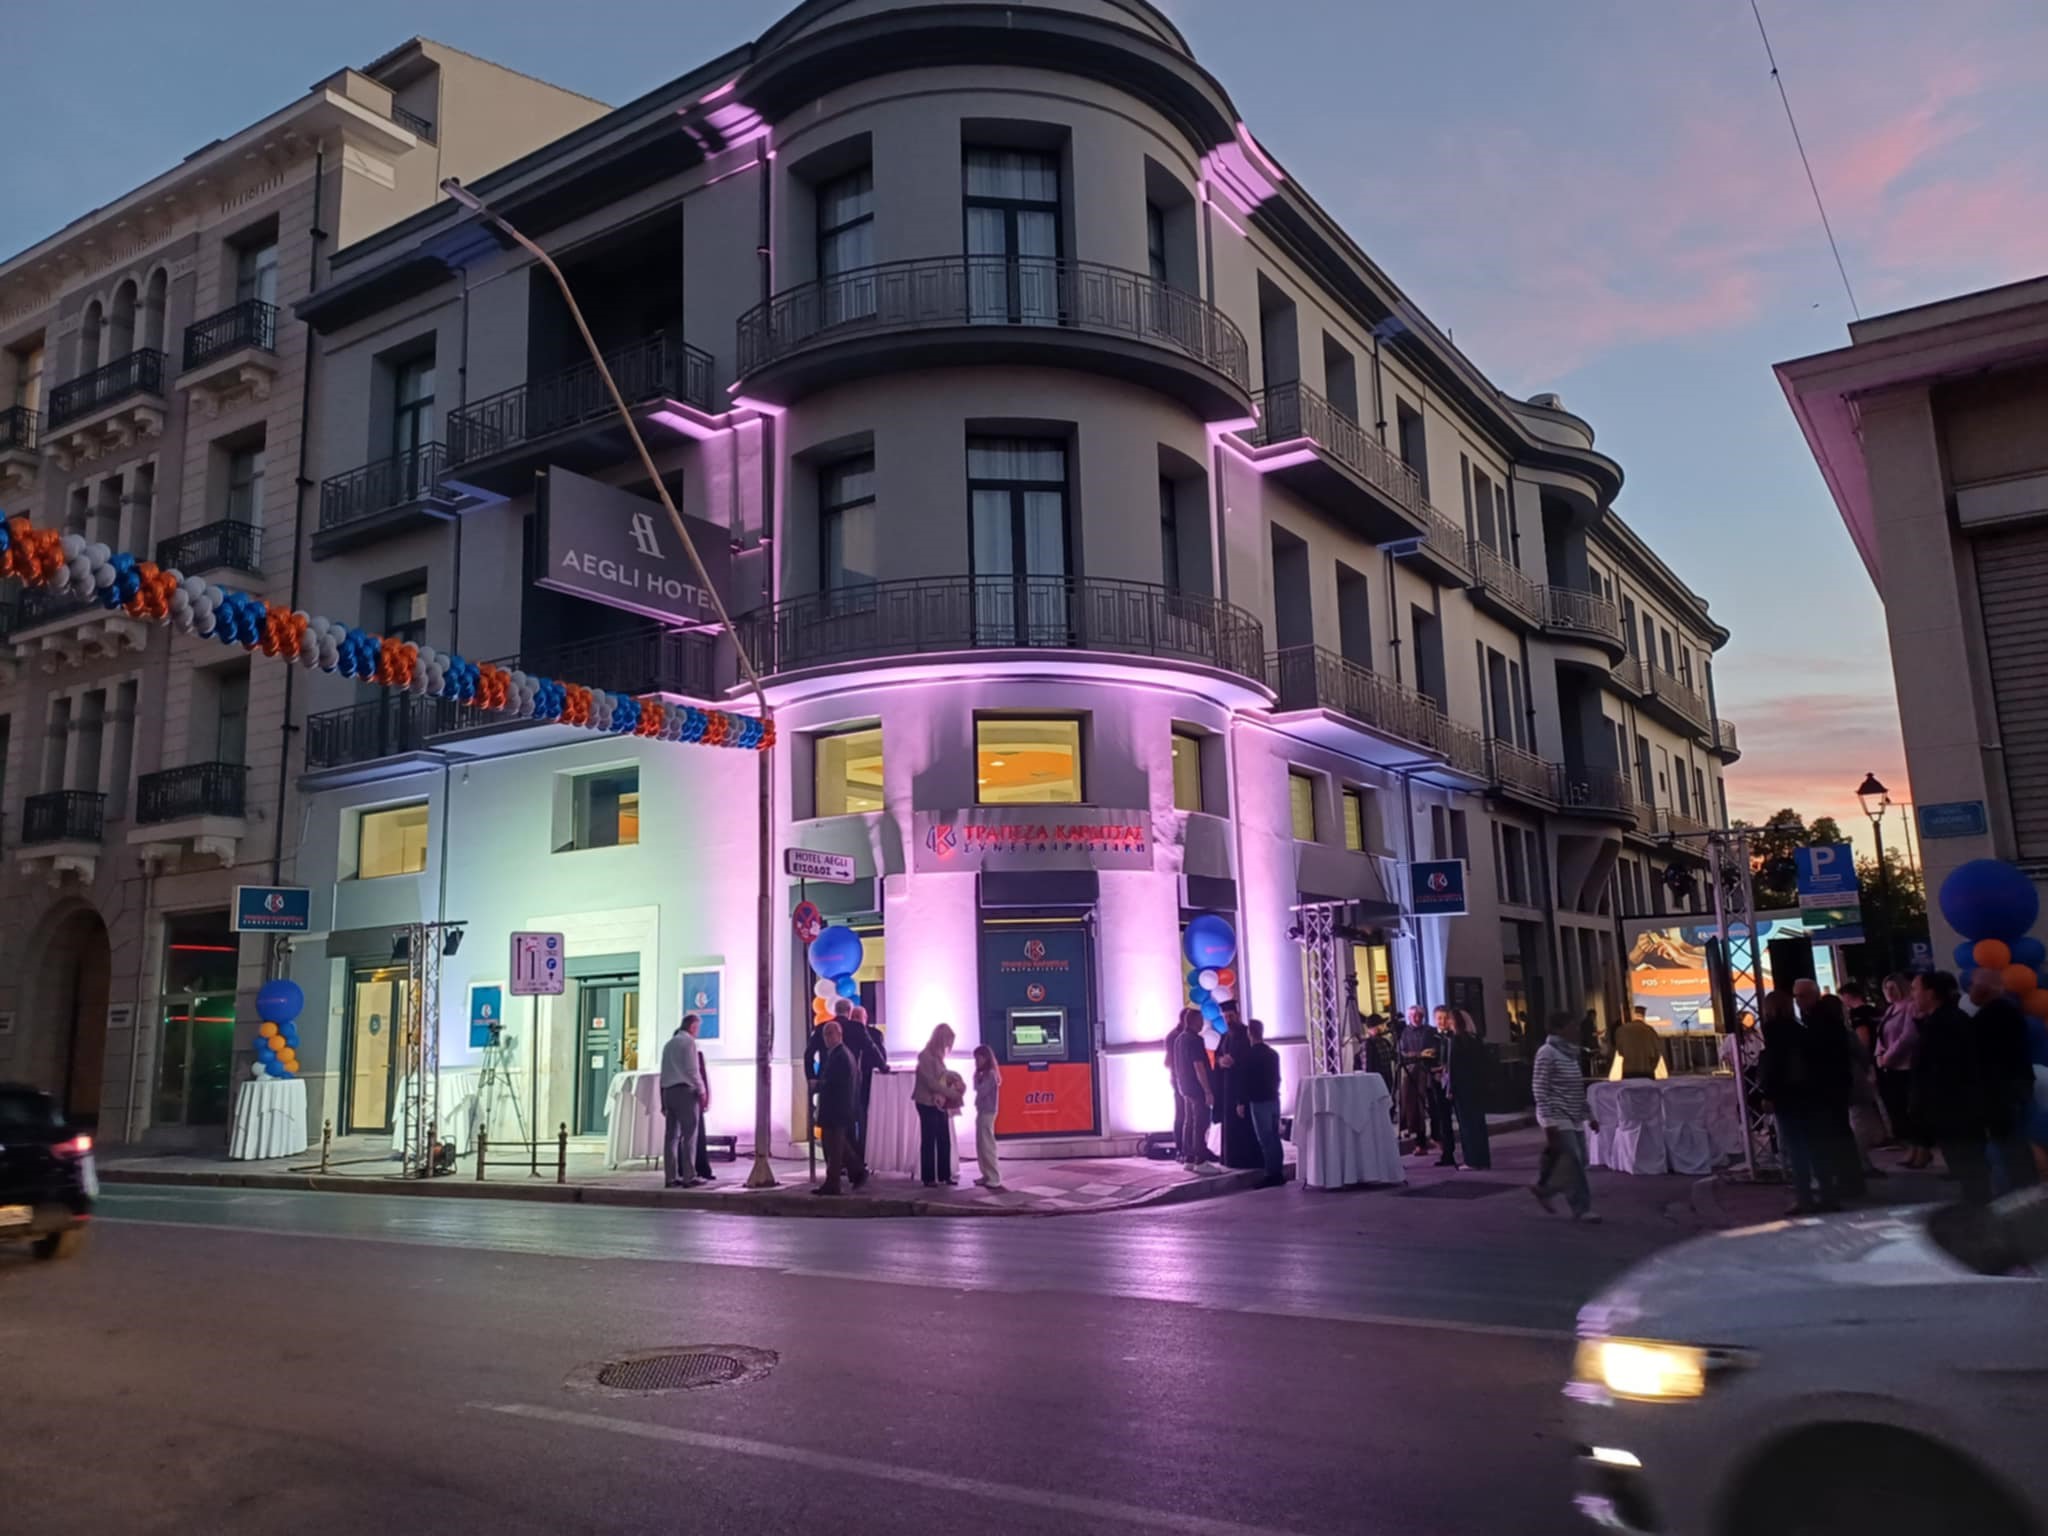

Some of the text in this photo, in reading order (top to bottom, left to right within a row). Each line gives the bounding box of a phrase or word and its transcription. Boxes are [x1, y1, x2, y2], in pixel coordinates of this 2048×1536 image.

[562, 549, 639, 588] AEGLI
[963, 824, 1049, 841] ΤΡΑΠΕΖΑ
[795, 852, 848, 867] HOTEL AEGLI
[1809, 846, 1835, 876] P
[1024, 1090, 1056, 1105] atm
